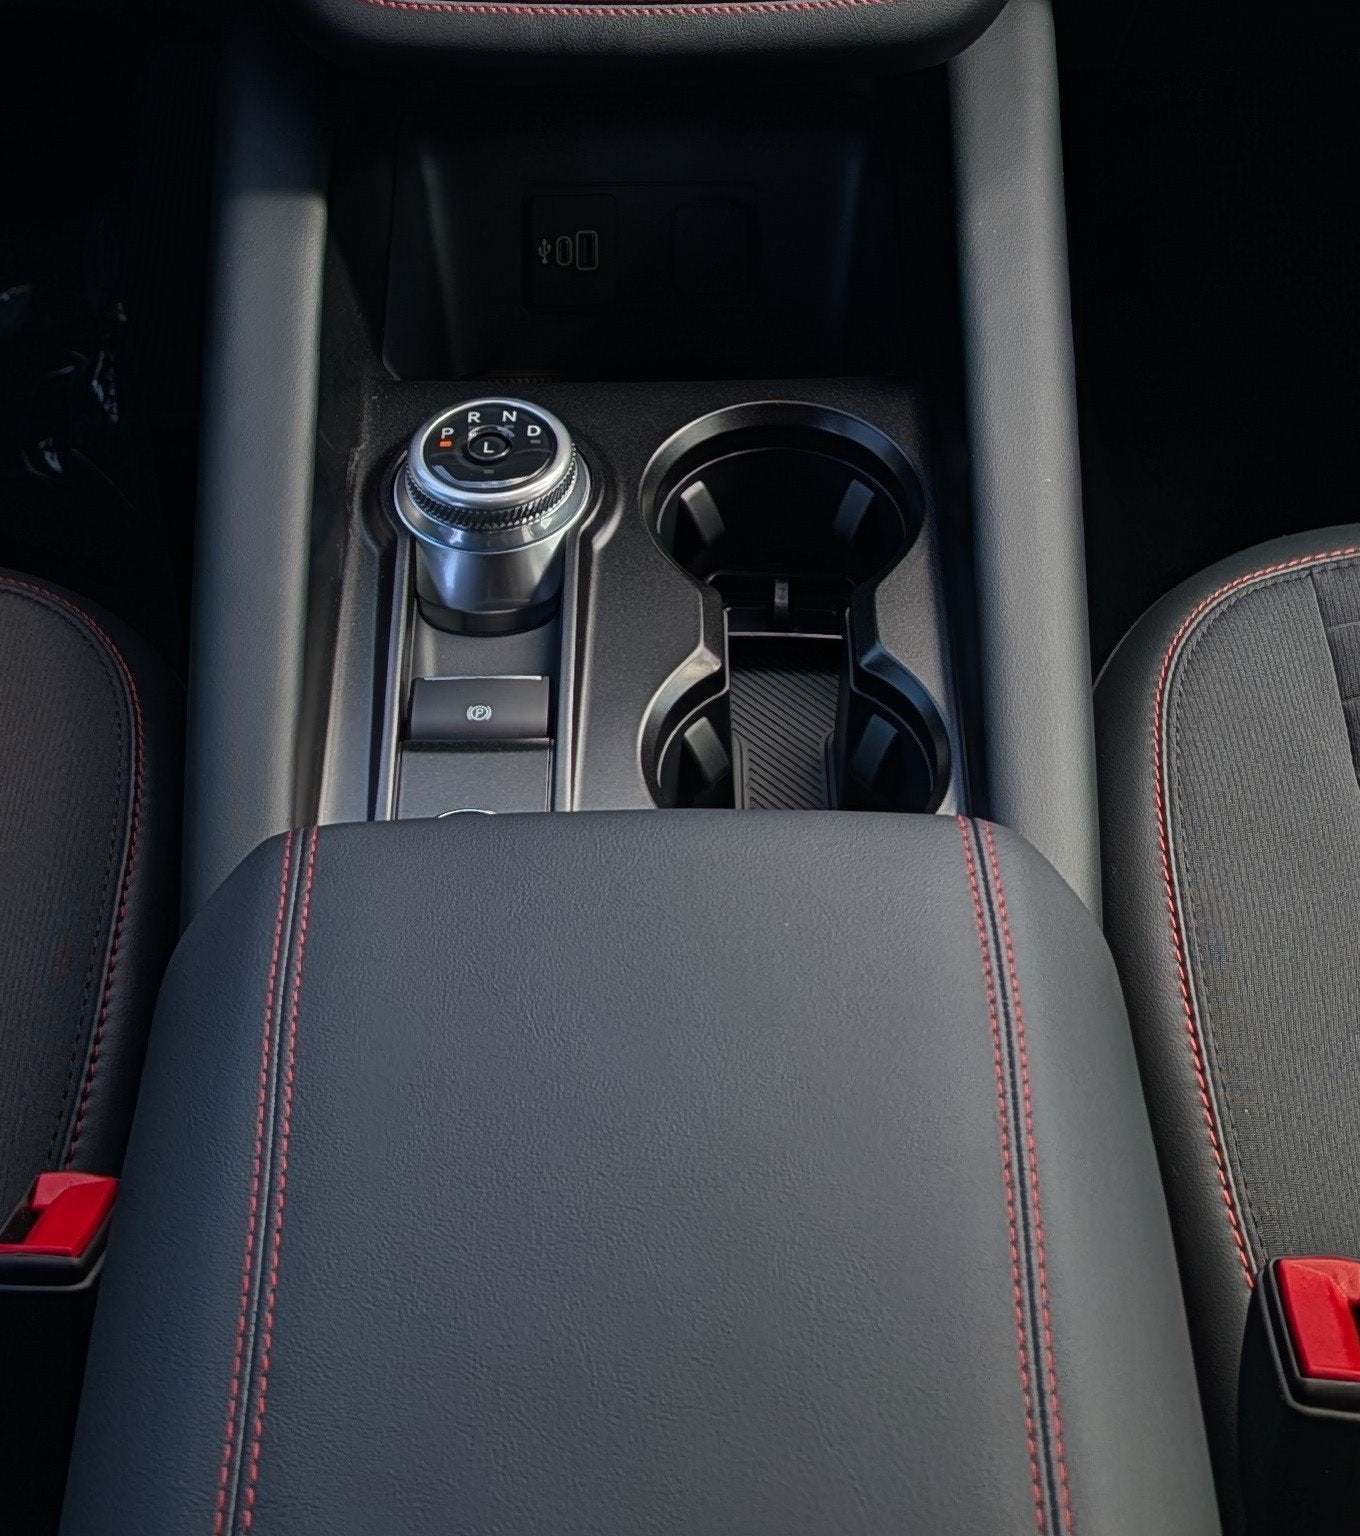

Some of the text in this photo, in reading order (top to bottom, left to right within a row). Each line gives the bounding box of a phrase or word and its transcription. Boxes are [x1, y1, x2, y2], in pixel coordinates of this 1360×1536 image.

[467, 411, 481, 424] R
[502, 410, 518, 423] N
[441, 427, 454, 440] P
[526, 425, 541, 438] D
[483, 441, 495, 454] L
